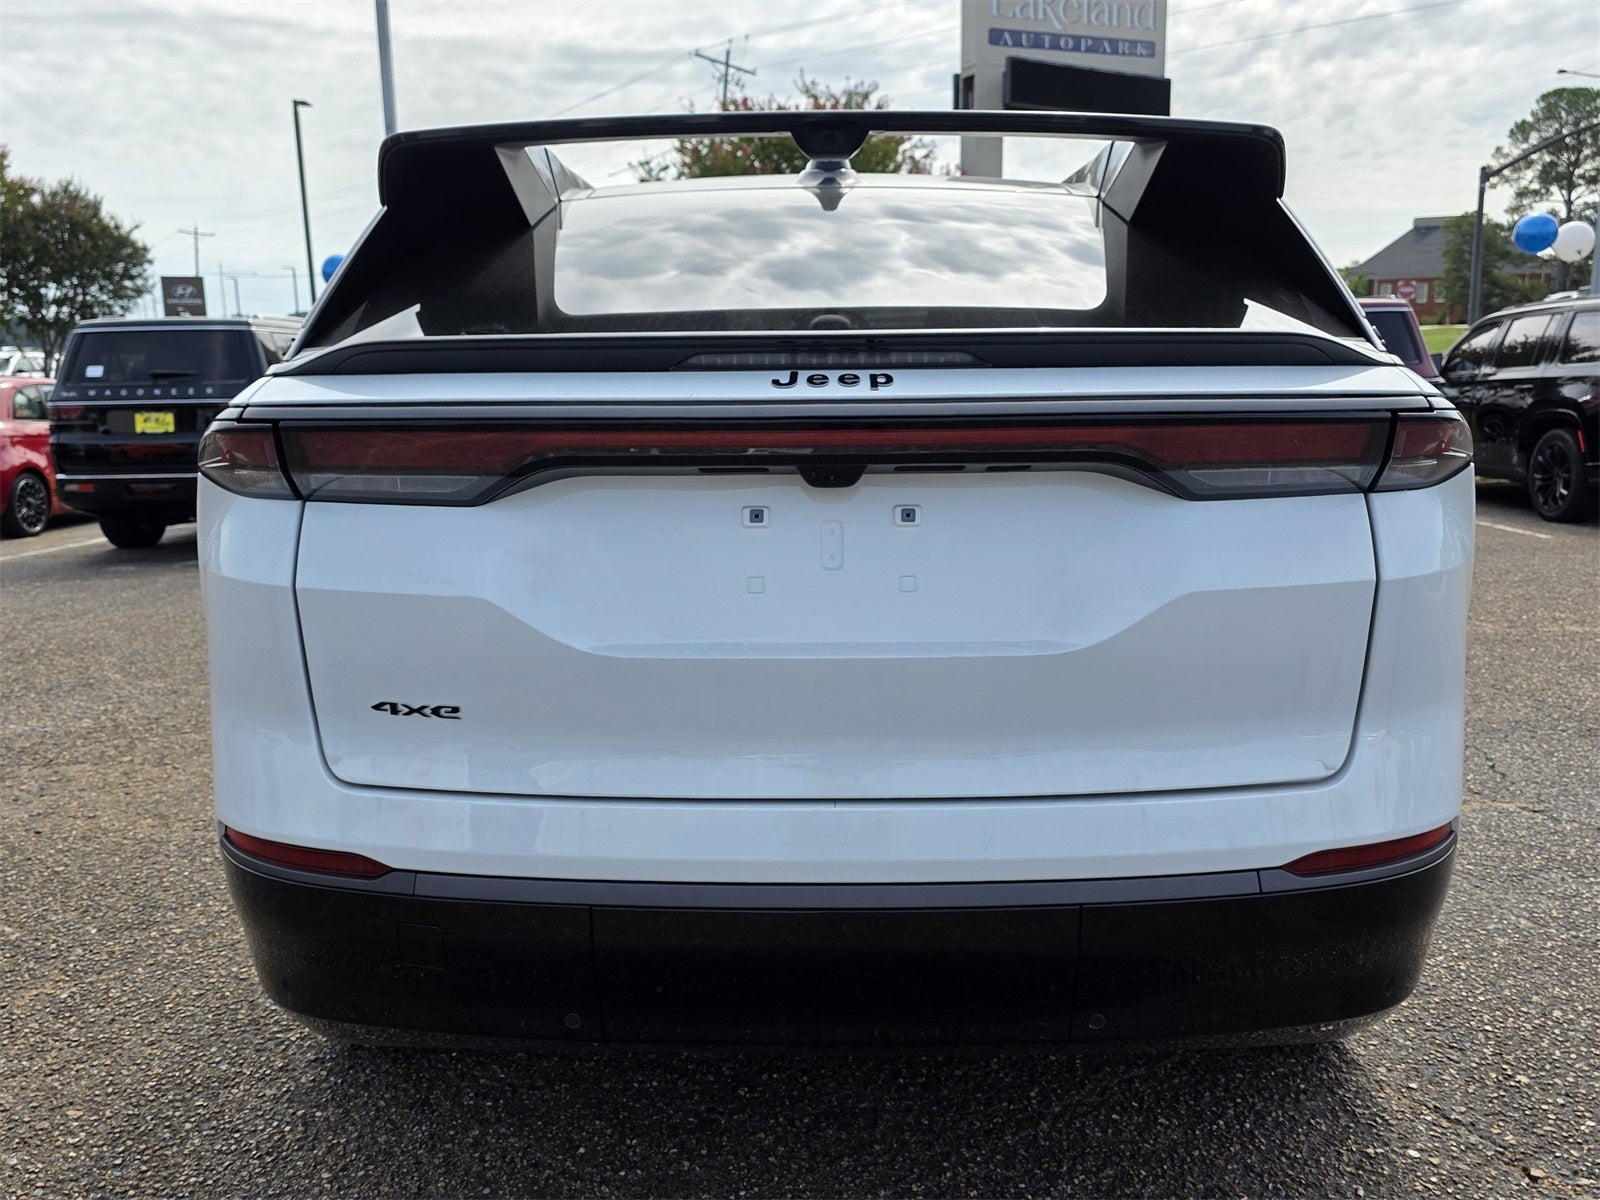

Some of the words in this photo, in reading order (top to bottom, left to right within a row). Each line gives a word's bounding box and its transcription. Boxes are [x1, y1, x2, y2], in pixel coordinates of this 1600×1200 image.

[991, 0, 1157, 31] Lakeland
[1001, 31, 1148, 56] AUTOPARK
[771, 370, 894, 390] Jeep
[88, 386, 213, 397] WAGONEER
